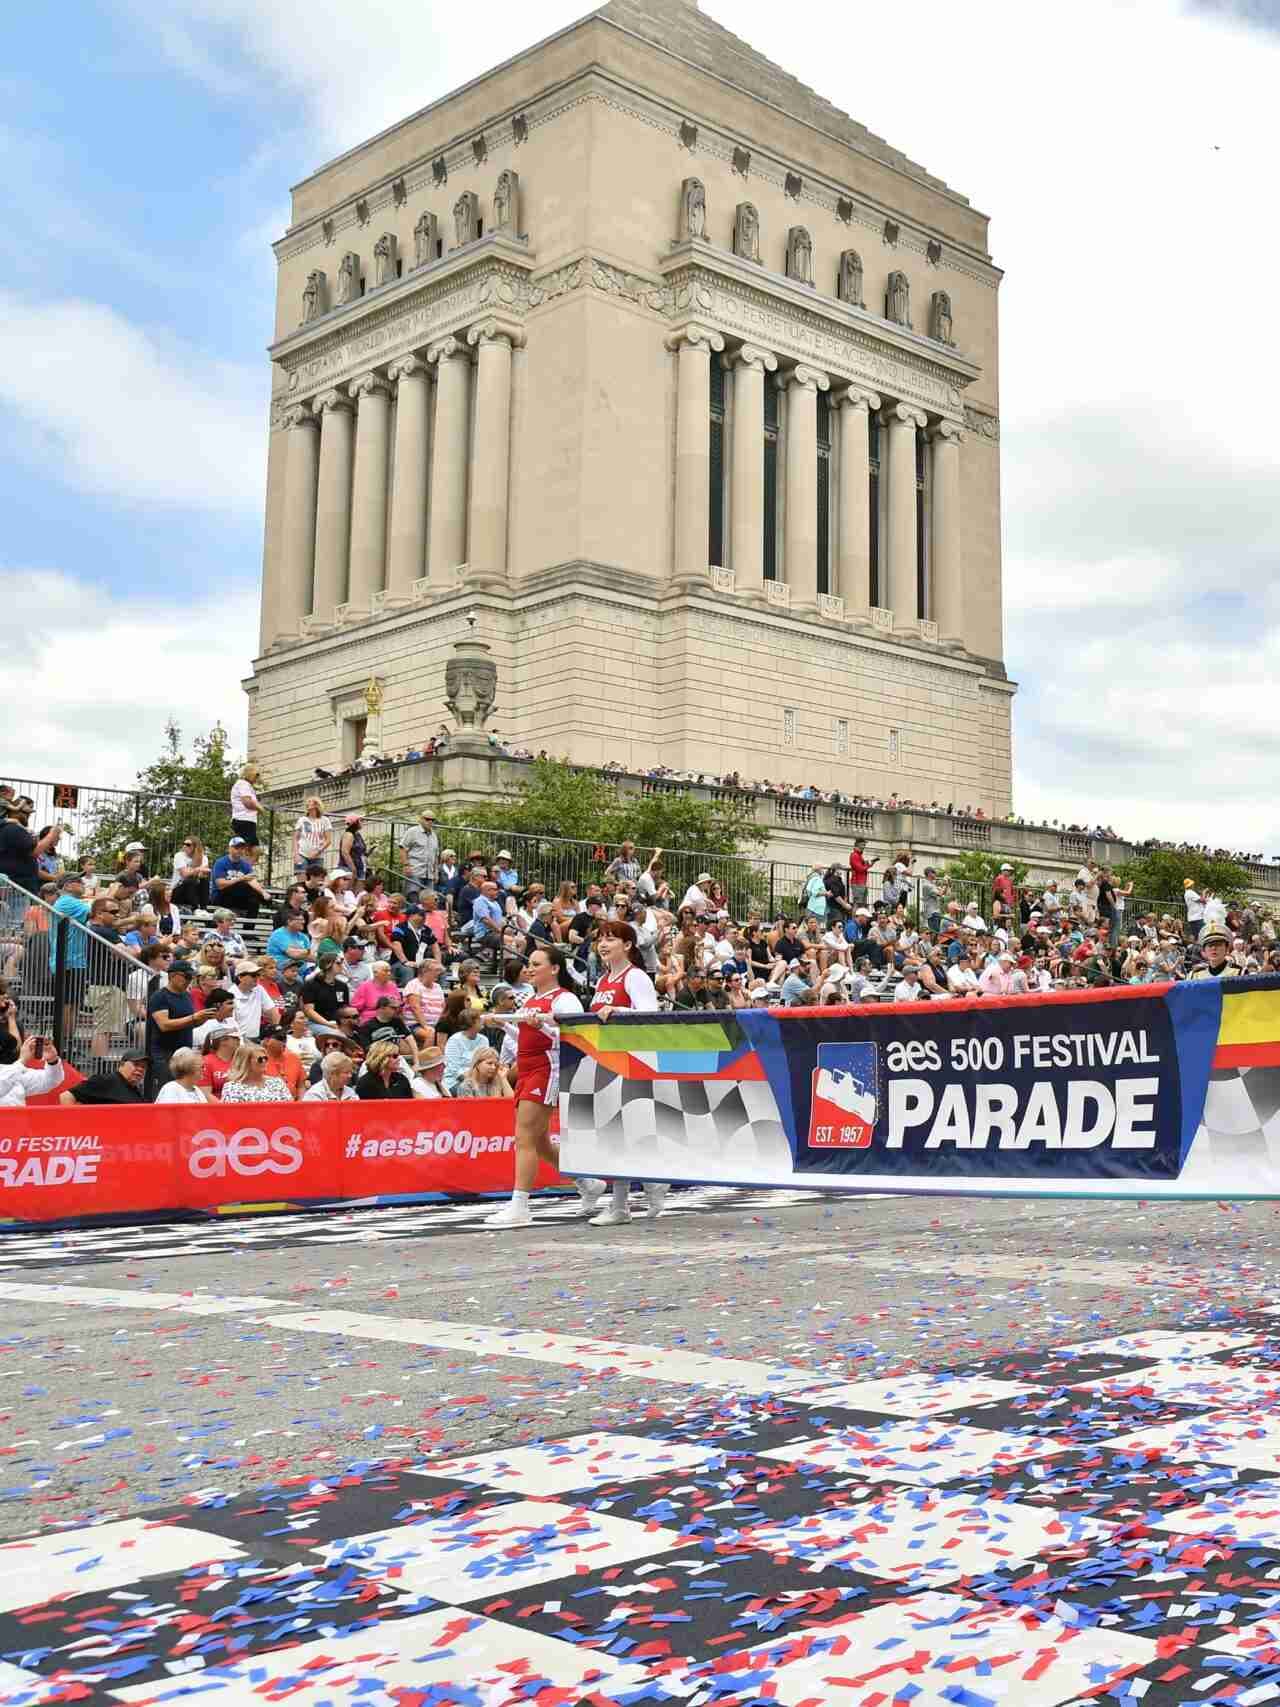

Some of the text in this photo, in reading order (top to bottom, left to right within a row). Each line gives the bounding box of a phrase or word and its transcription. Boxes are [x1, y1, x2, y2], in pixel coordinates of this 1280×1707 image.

[885, 1030, 1160, 1072] aes 500 FESTIVAL
[885, 1077, 1159, 1149] PARADE
[16, 1135, 103, 1153] FESTIVAL
[345, 1131, 560, 1159] #aes500pare
[816, 1126, 864, 1143] EST. 1957
[188, 1126, 304, 1179] aes
